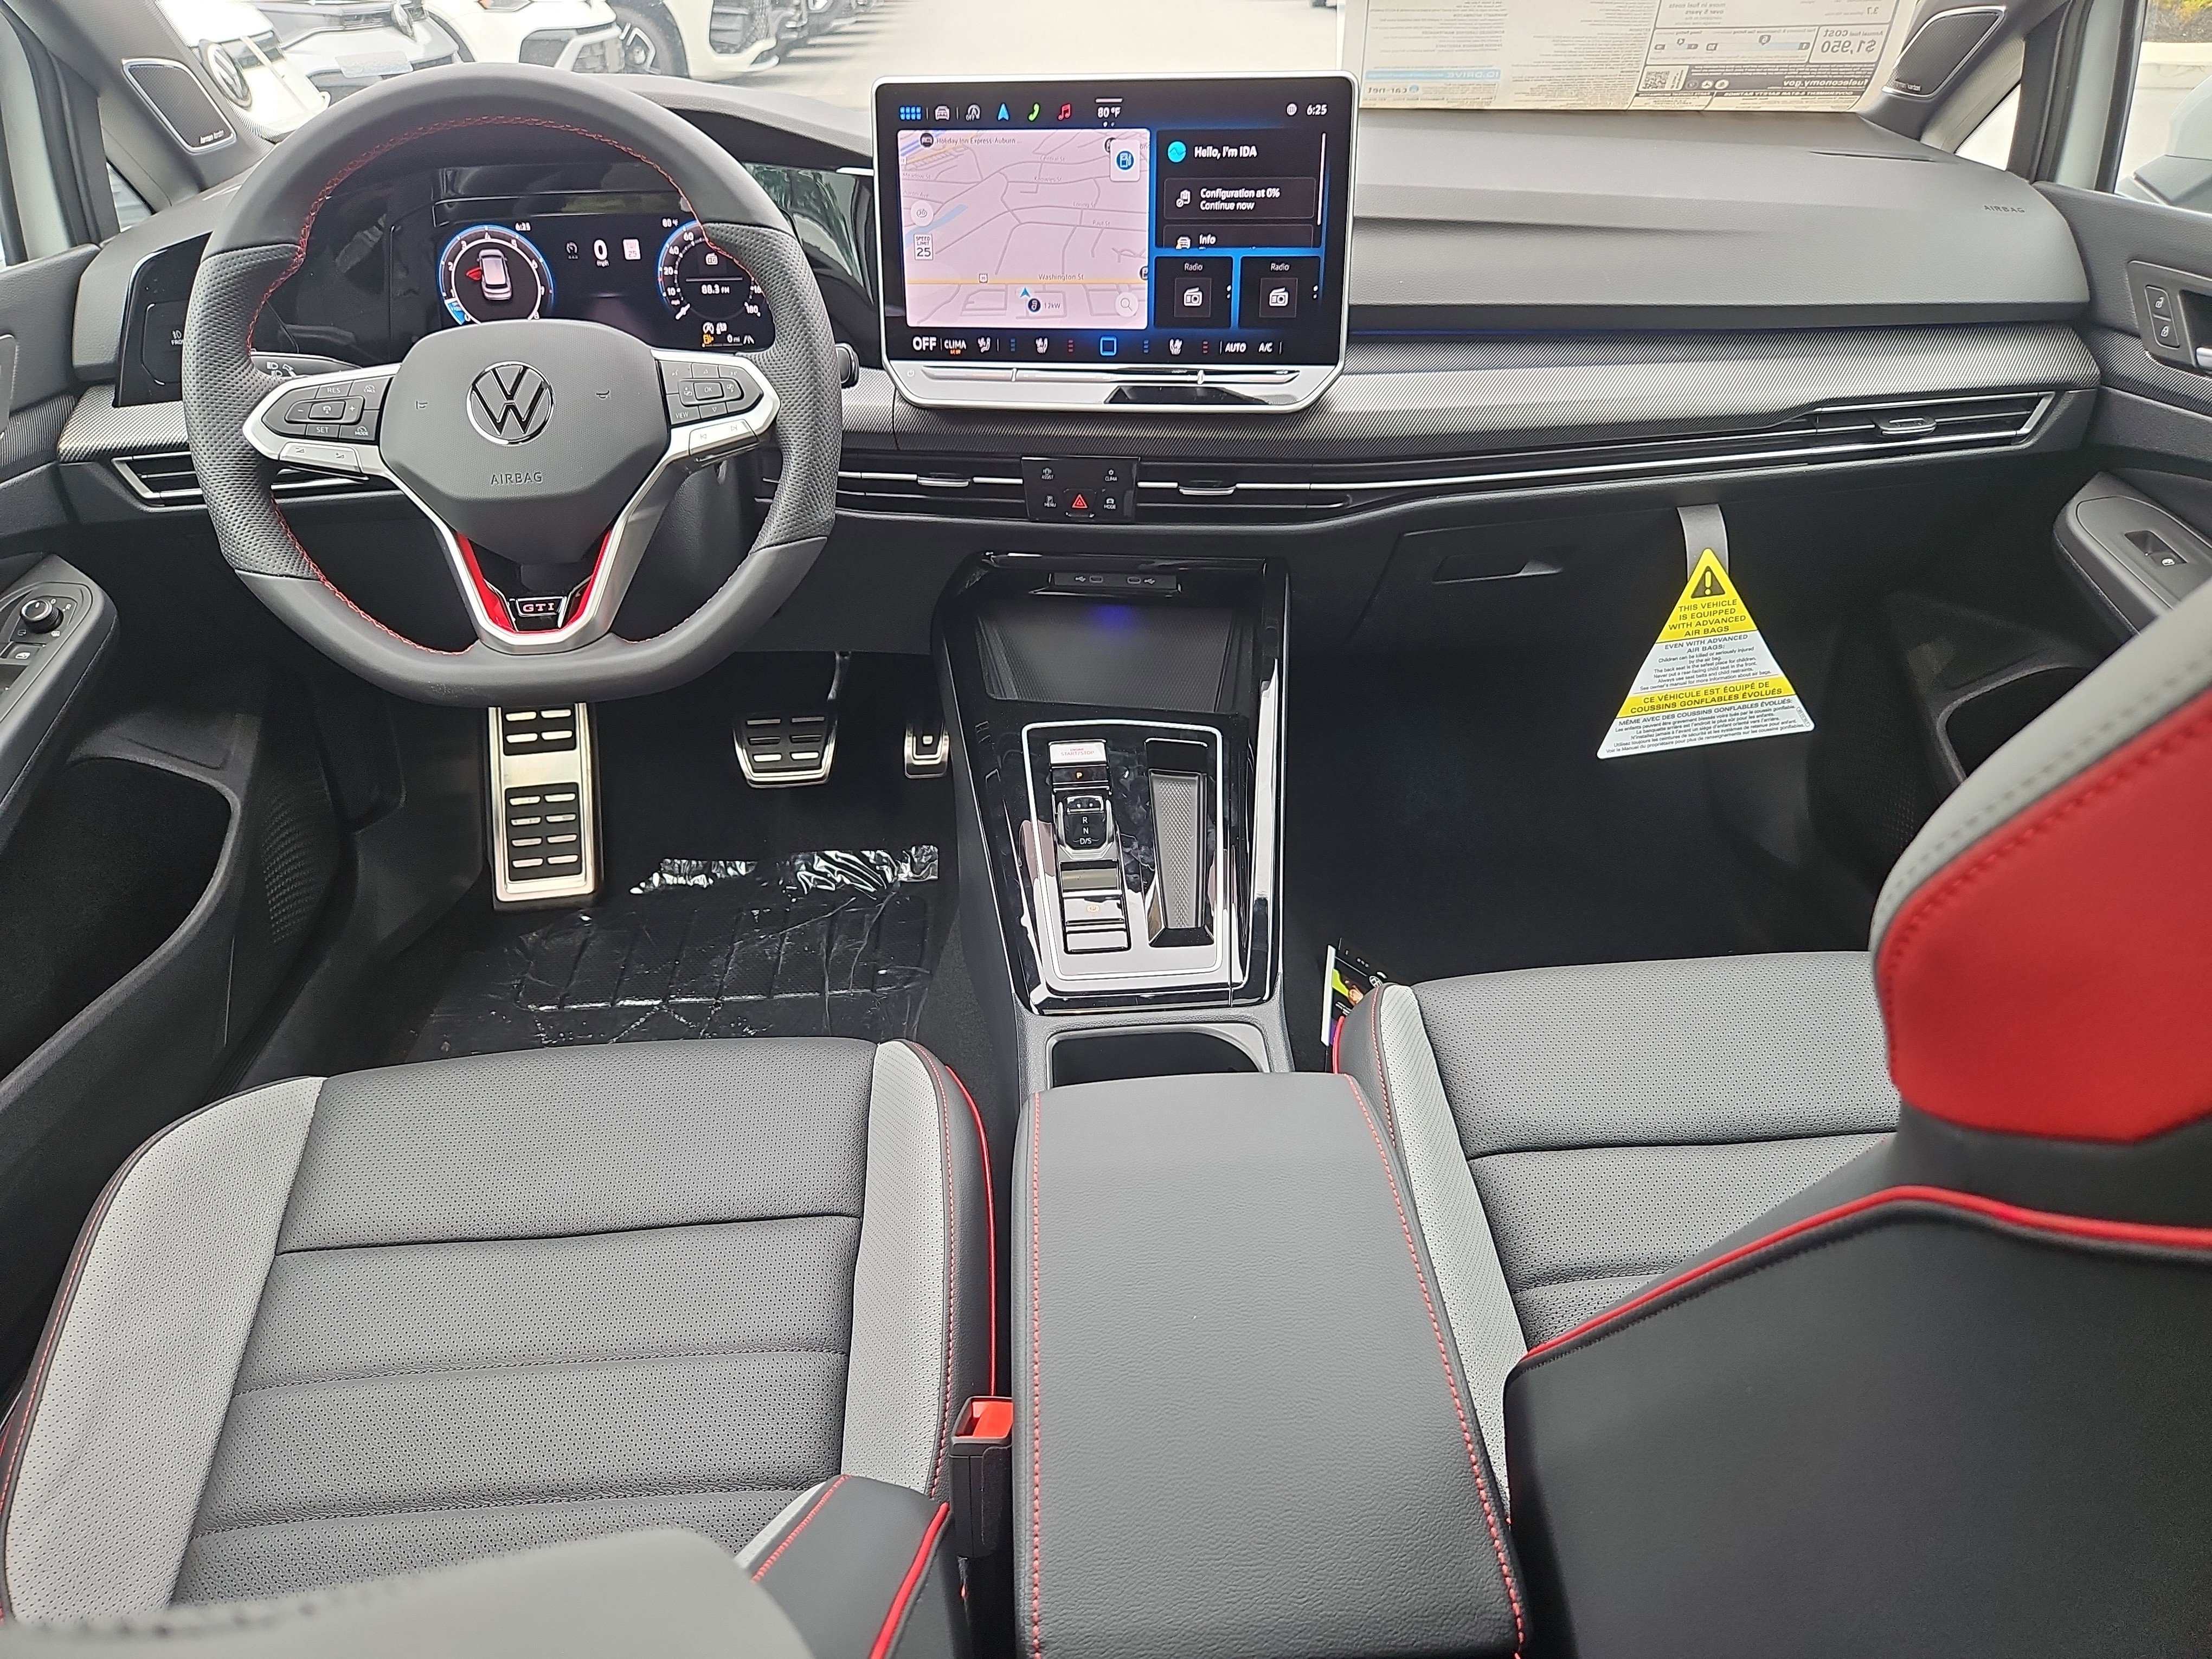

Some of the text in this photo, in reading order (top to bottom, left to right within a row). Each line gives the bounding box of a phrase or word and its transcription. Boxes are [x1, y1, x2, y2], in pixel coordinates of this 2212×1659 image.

[1097, 107, 1109, 118] 80
[1307, 104, 1327, 115] 6:25
[1194, 146, 1257, 159] Hello, I'm IDA
[1200, 188, 1280, 200] Configuration at 0%
[1200, 201, 1255, 210] Continue now
[1984, 205, 2025, 213] AIRBAG
[683, 232, 694, 241] 60
[1199, 234, 1216, 245] Info
[594, 240, 607, 260] 0
[669, 246, 679, 255] 40
[917, 247, 931, 257] 25
[664, 267, 673, 275] 20
[1184, 262, 1203, 271] Radio
[1271, 262, 1289, 271] Radio
[1038, 273, 1075, 282] Washington
[667, 287, 676, 296] 10
[913, 337, 937, 350] OFF
[944, 339, 966, 349] CLIMA
[1225, 343, 1246, 352] AUTO
[1259, 343, 1273, 352] A/C
[491, 472, 542, 485] AIRBAG
[523, 602, 554, 612] GTI
[1678, 599, 1737, 612] THIS VEHICLE
[1690, 607, 1736, 619] EQUIPPED
[1668, 614, 1746, 630] WITH ADVANCED
[1703, 625, 1729, 634] BAGS
[1706, 634, 1748, 644] ADVANCED
[1657, 689, 1701, 702] VÉHICULE
[1703, 687, 1722, 696] EST
[1722, 681, 1756, 693] ÉQUIPÉ
[1630, 687, 1782, 713] COUSSINS GONFLABLES ÉVOLUÉS
[1676, 709, 1712, 718] COUSSINS
[1713, 703, 1759, 713] GONFLABLES
[1760, 698, 1792, 707] ÉVOLUÉS:
